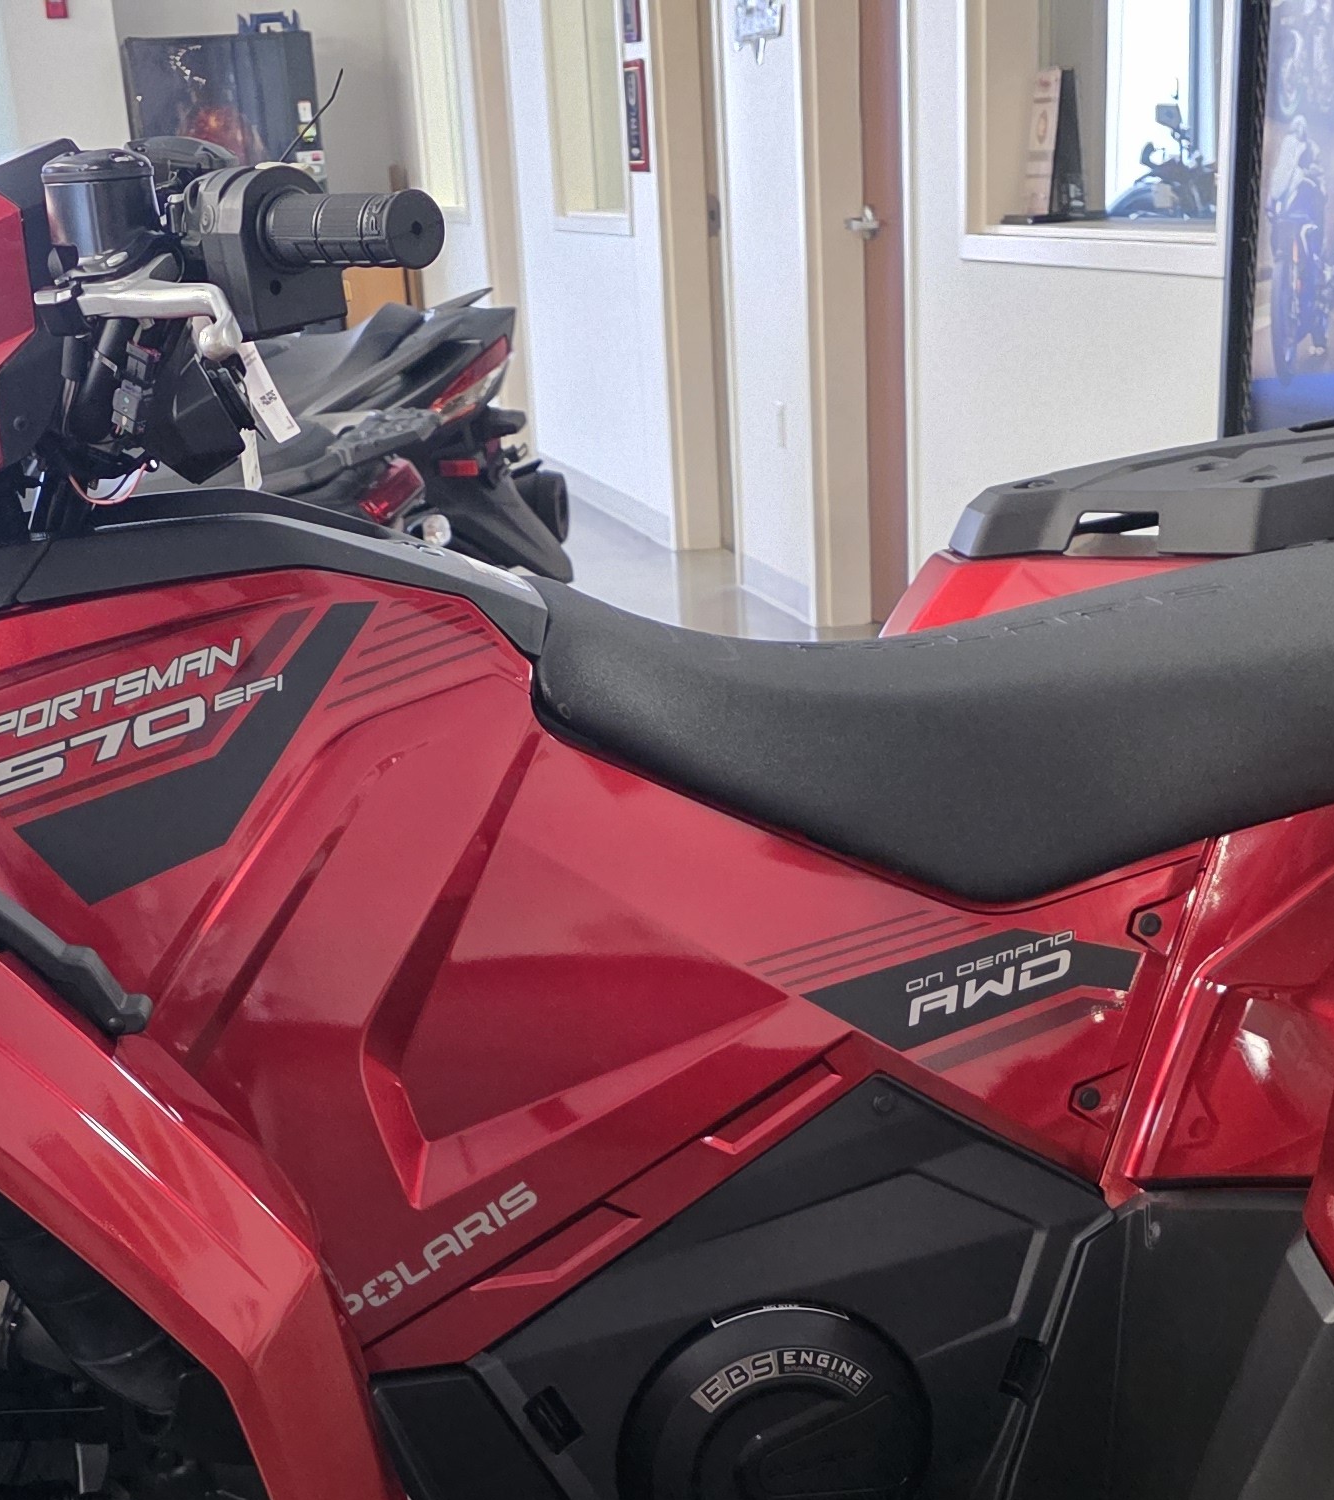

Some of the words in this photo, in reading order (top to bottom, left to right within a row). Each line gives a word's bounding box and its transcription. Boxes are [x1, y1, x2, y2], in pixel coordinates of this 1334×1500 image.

[214, 673, 283, 713] EFI
[905, 971, 944, 993] ON
[956, 930, 1074, 977] DEMAND
[908, 949, 1072, 1027] AWD
[700, 1353, 775, 1406] EBS
[782, 1351, 868, 1386] ENGINE
